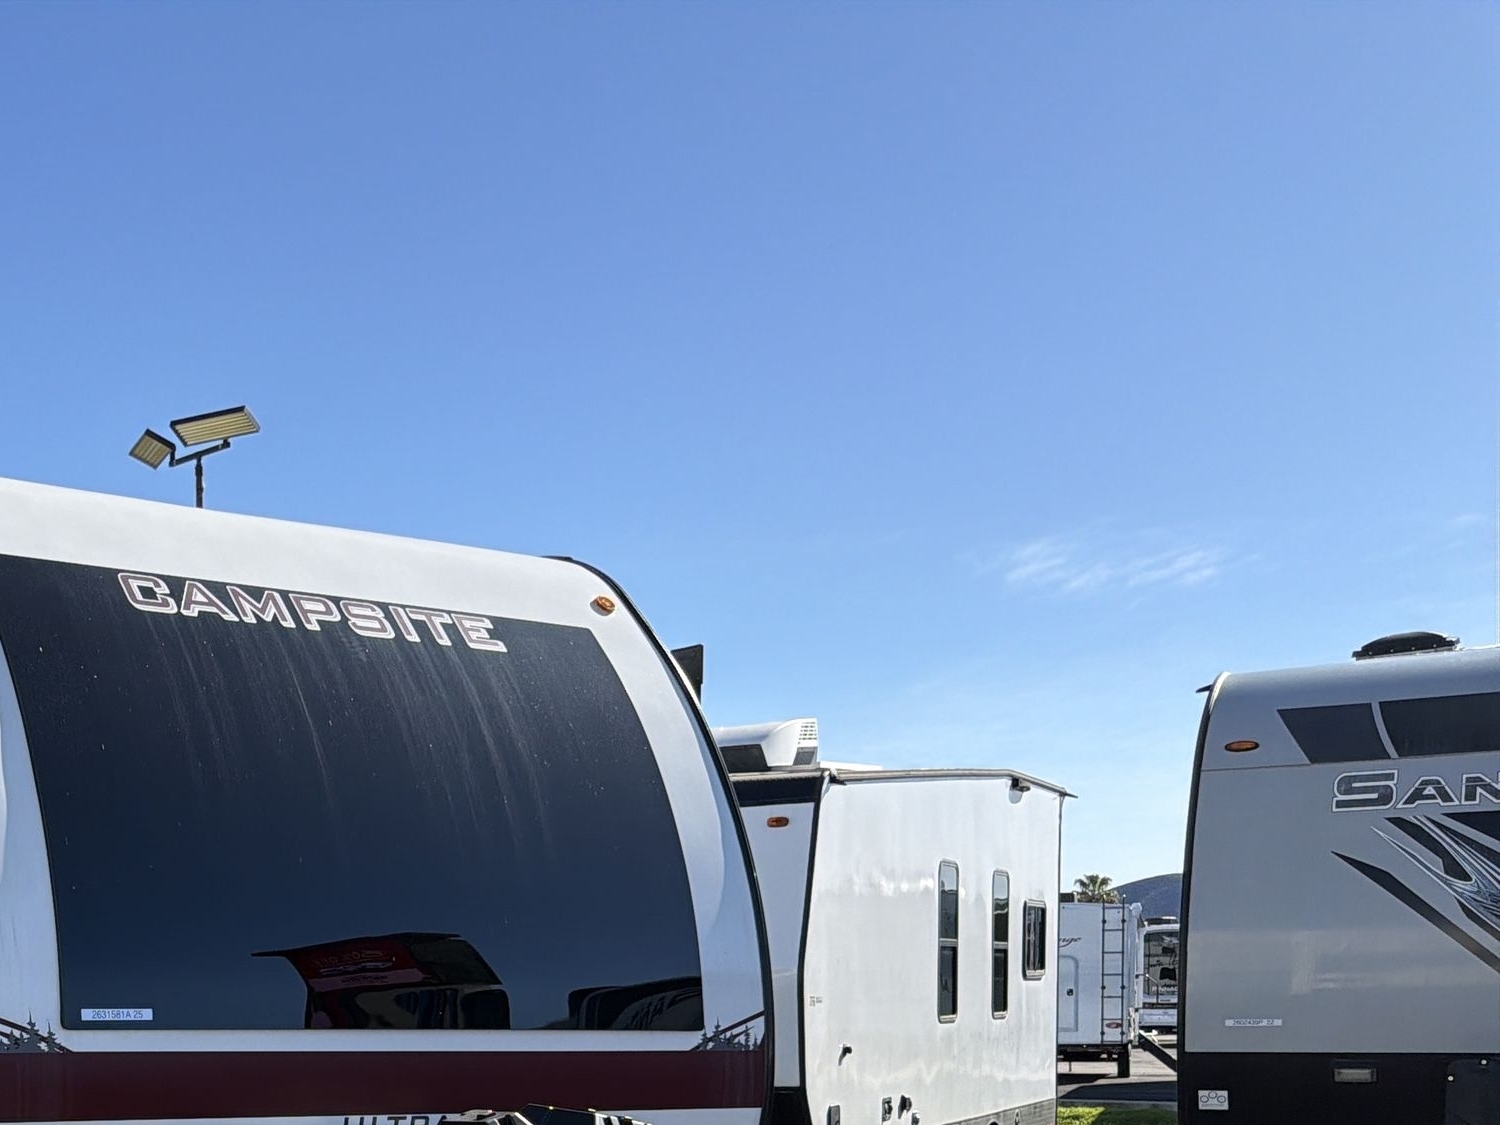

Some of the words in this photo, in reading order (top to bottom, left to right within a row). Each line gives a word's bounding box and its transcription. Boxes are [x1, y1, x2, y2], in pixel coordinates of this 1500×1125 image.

[117, 572, 508, 653] CAMPSITE
[92, 1010, 131, 1019] 2631581A
[133, 1010, 143, 1019] 25
